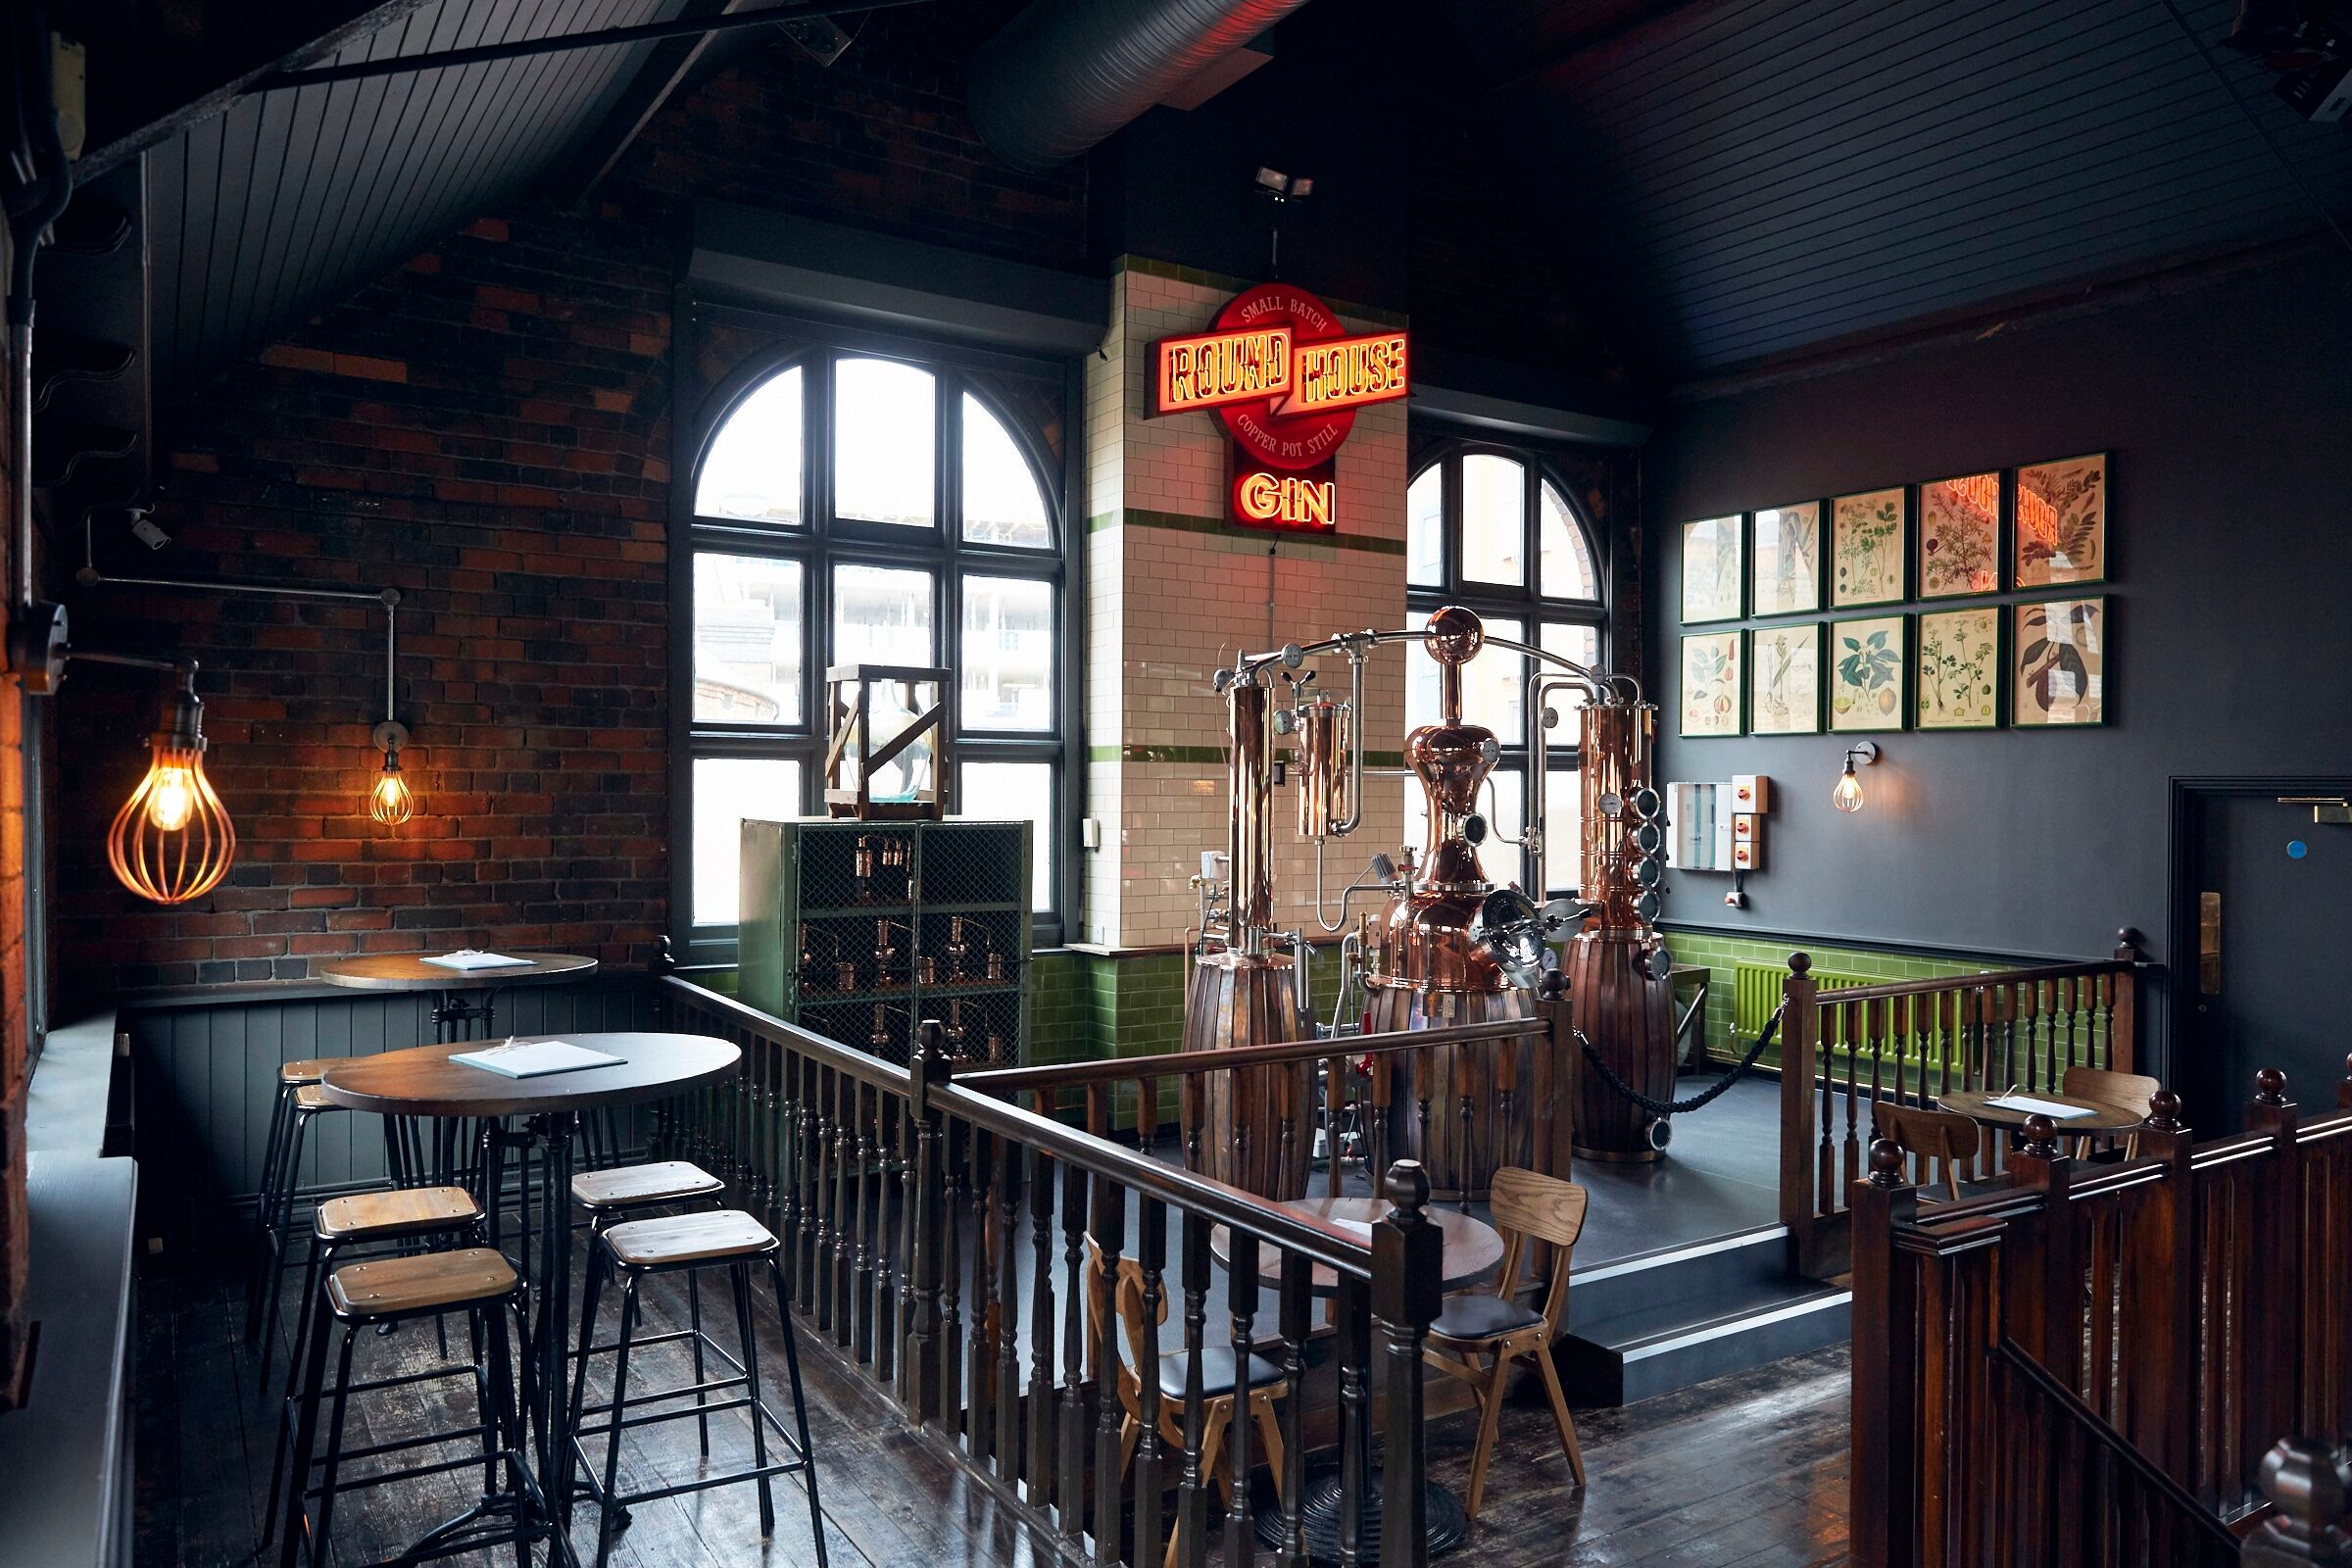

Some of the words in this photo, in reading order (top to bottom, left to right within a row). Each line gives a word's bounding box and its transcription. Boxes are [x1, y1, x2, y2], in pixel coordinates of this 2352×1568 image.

[1241, 296, 1284, 323] SMALL
[1290, 298, 1328, 333] BATCH
[1168, 332, 1290, 404] ROUND
[1301, 338, 1405, 404] HOUSE
[1237, 413, 1277, 453] COPPER
[1281, 442, 1303, 458] POT
[1308, 423, 1339, 456] STILL
[1240, 472, 1337, 525] GIN
